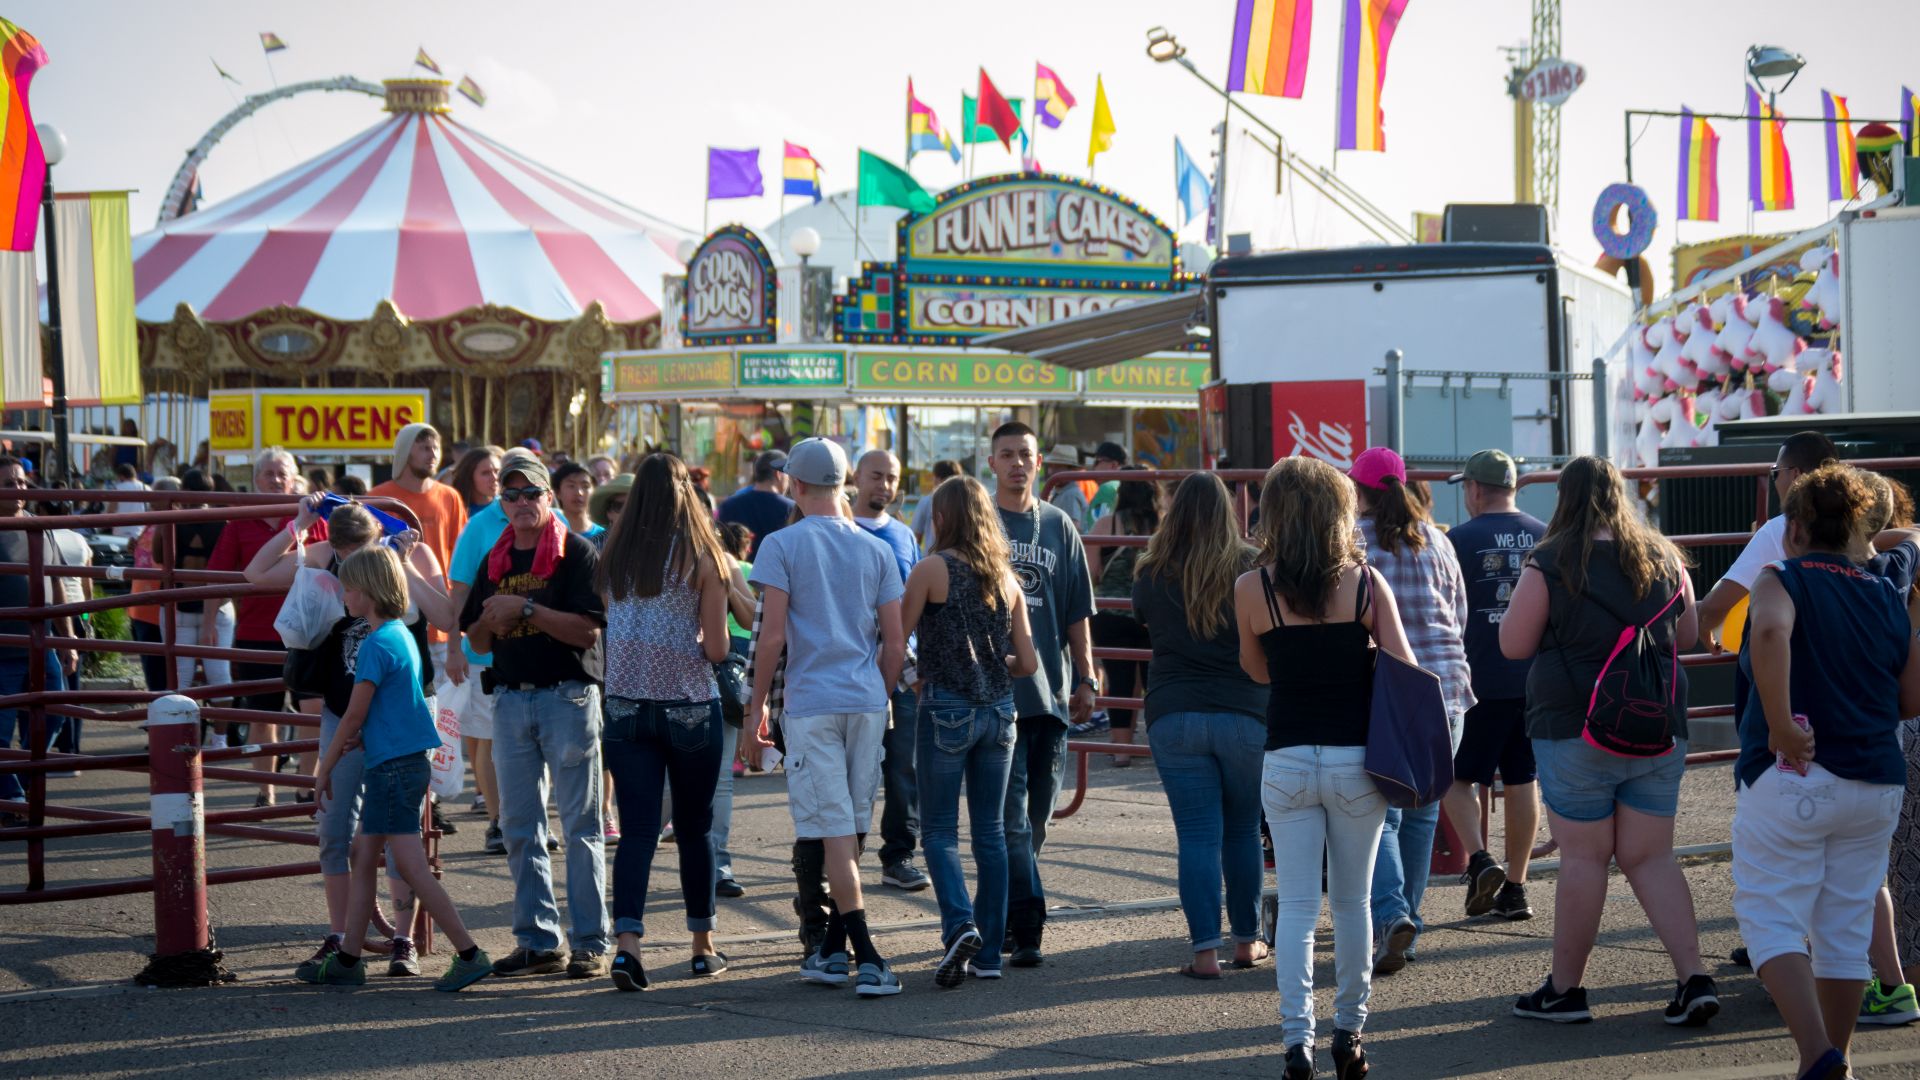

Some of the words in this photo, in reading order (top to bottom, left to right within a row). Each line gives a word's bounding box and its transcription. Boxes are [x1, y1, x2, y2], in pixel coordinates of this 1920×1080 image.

[934, 191, 1051, 255] FUNNEL
[1057, 192, 1150, 256] CAKES
[694, 251, 753, 292] CORN
[694, 282, 753, 324] DOGS
[925, 297, 1036, 329] CORN
[1051, 297, 1138, 324] DO
[621, 363, 658, 385] FRESH
[663, 360, 730, 384] LEMONADE
[871, 361, 959, 382] CORN
[972, 363, 1056, 384] DOGS
[1096, 366, 1192, 387] FUNNEL
[211, 409, 246, 438] TOKENS
[274, 405, 414, 442] TOKENS
[1494, 533, 1515, 548] we
